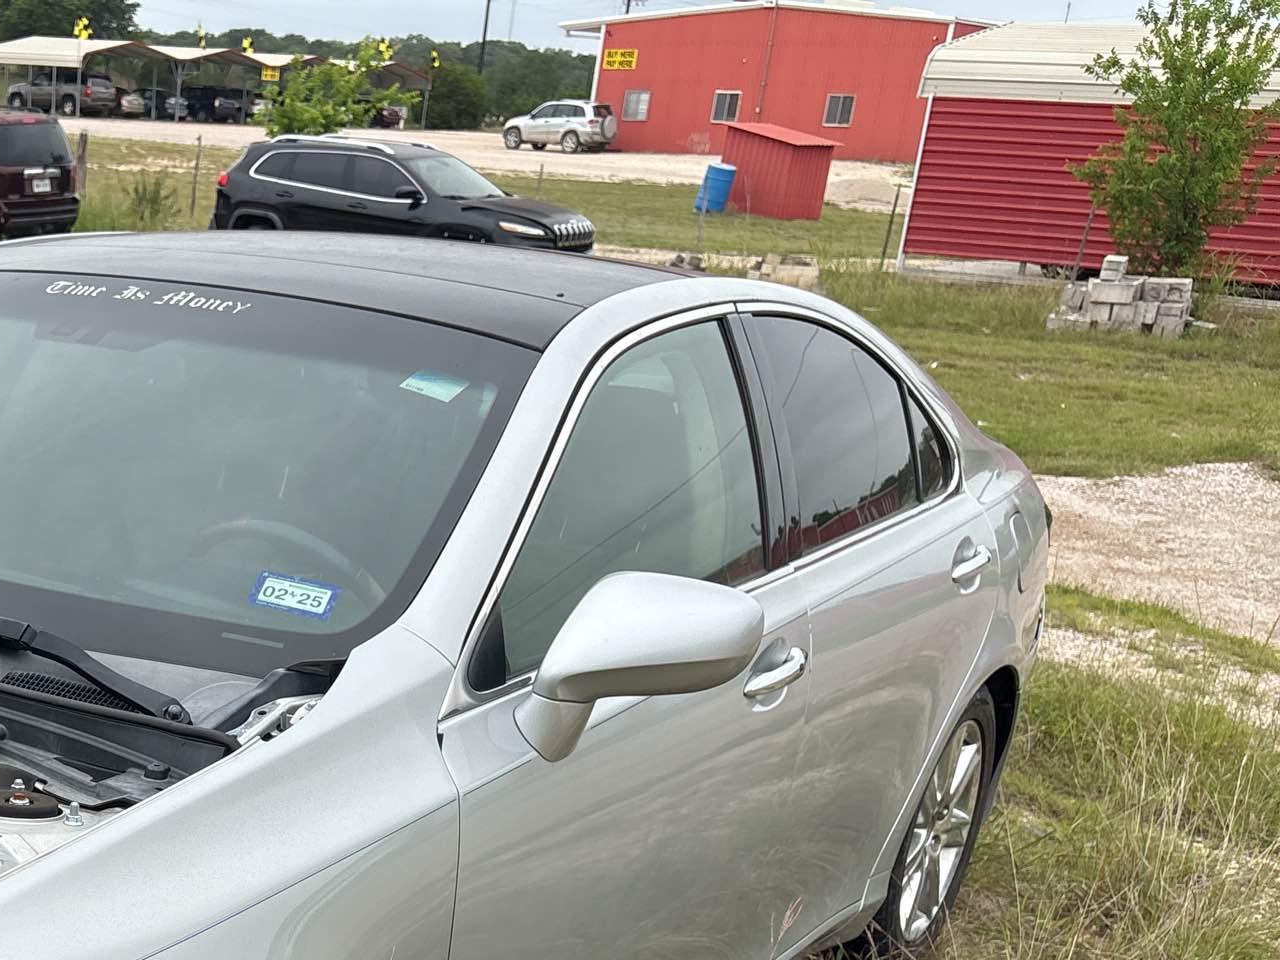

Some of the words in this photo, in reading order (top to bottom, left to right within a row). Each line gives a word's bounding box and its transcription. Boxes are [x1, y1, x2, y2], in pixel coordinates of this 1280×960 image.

[46, 280, 107, 297] Time
[113, 285, 150, 300] Is
[153, 290, 252, 314] Money
